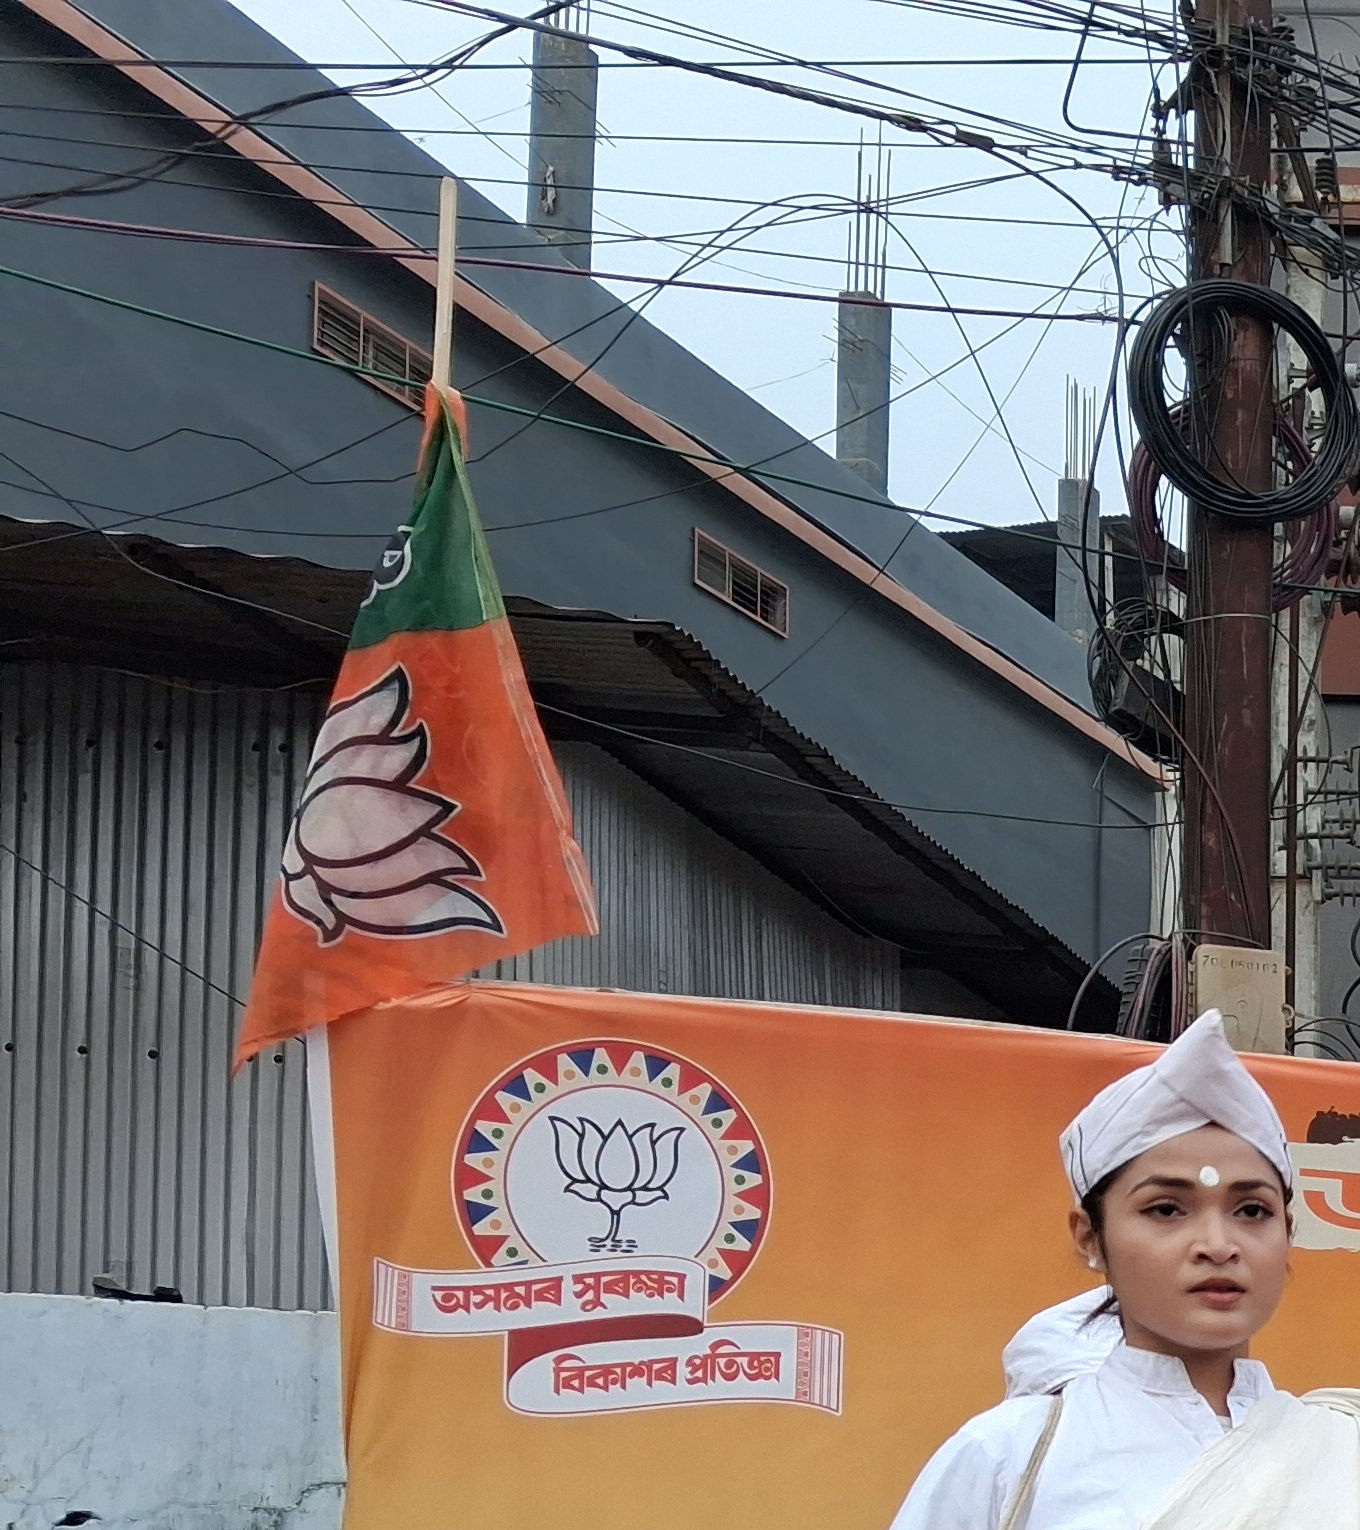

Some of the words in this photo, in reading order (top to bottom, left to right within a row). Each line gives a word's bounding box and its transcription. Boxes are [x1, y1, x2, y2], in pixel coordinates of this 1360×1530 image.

[431, 1277, 563, 1314] অসমৰ
[572, 1271, 687, 1310] সুৰক্ষা
[552, 1353, 677, 1396] বিকাশৰ
